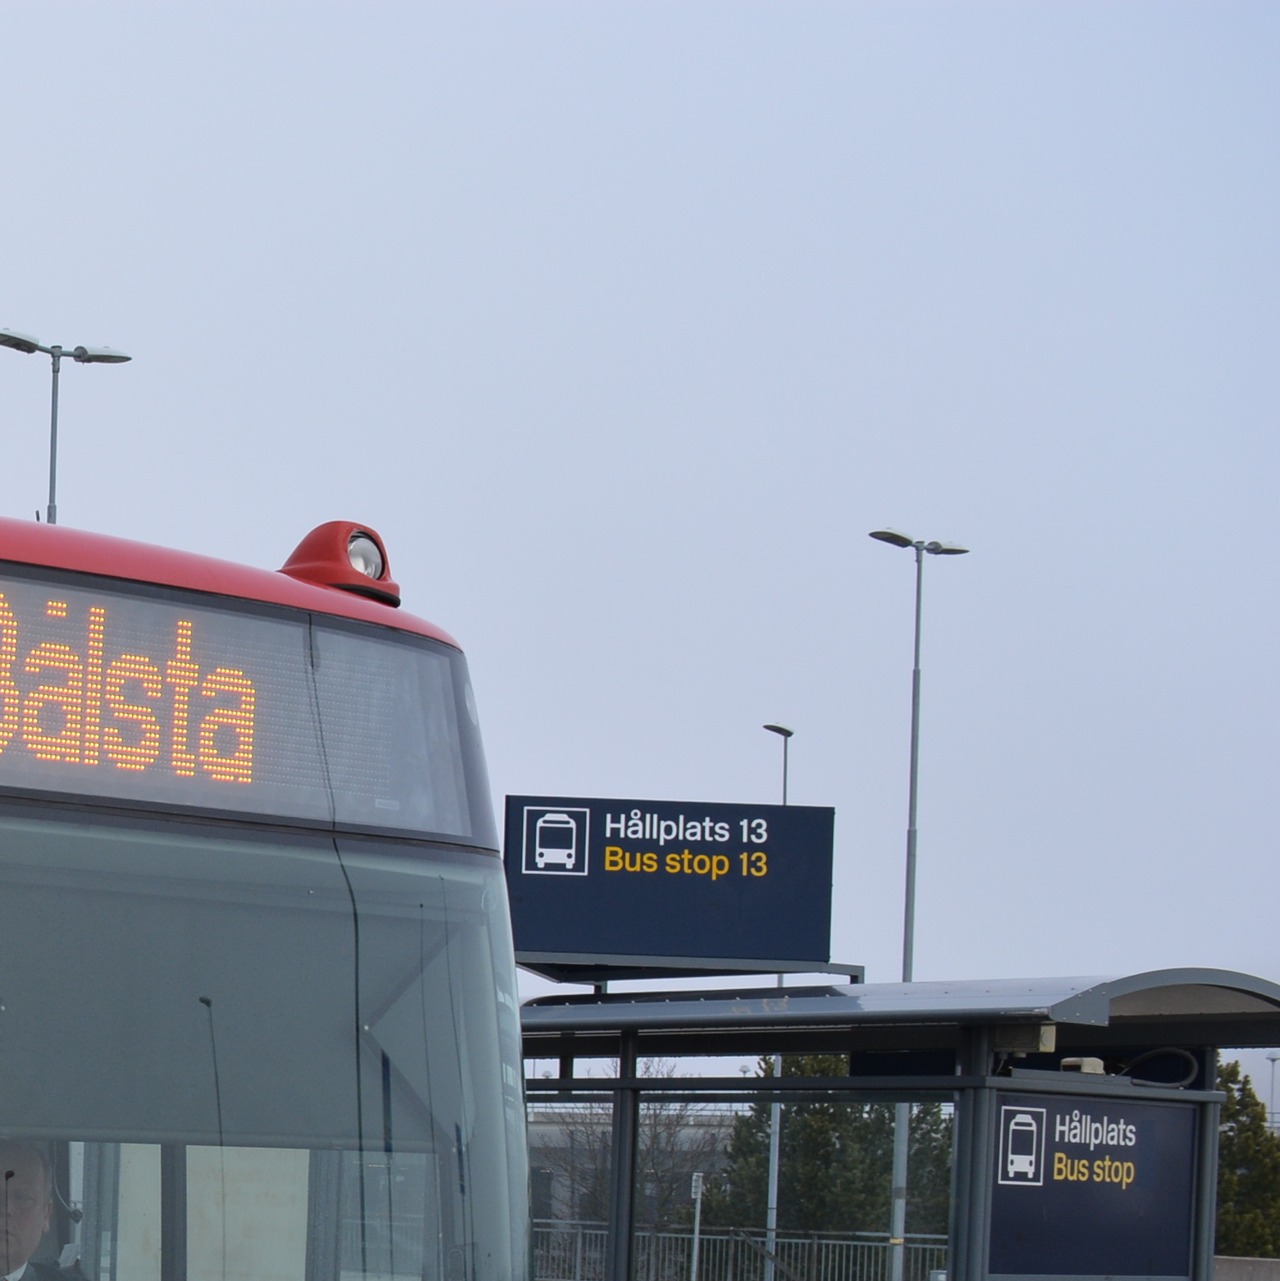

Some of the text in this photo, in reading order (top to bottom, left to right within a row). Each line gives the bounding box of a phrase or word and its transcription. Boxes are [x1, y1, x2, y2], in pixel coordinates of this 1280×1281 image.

[605, 808, 768, 846] Hållplats 13
[604, 846, 768, 881] Bus stop 13
[1055, 1109, 1136, 1151] Hållplats
[1053, 1152, 1135, 1190] Bus stop
